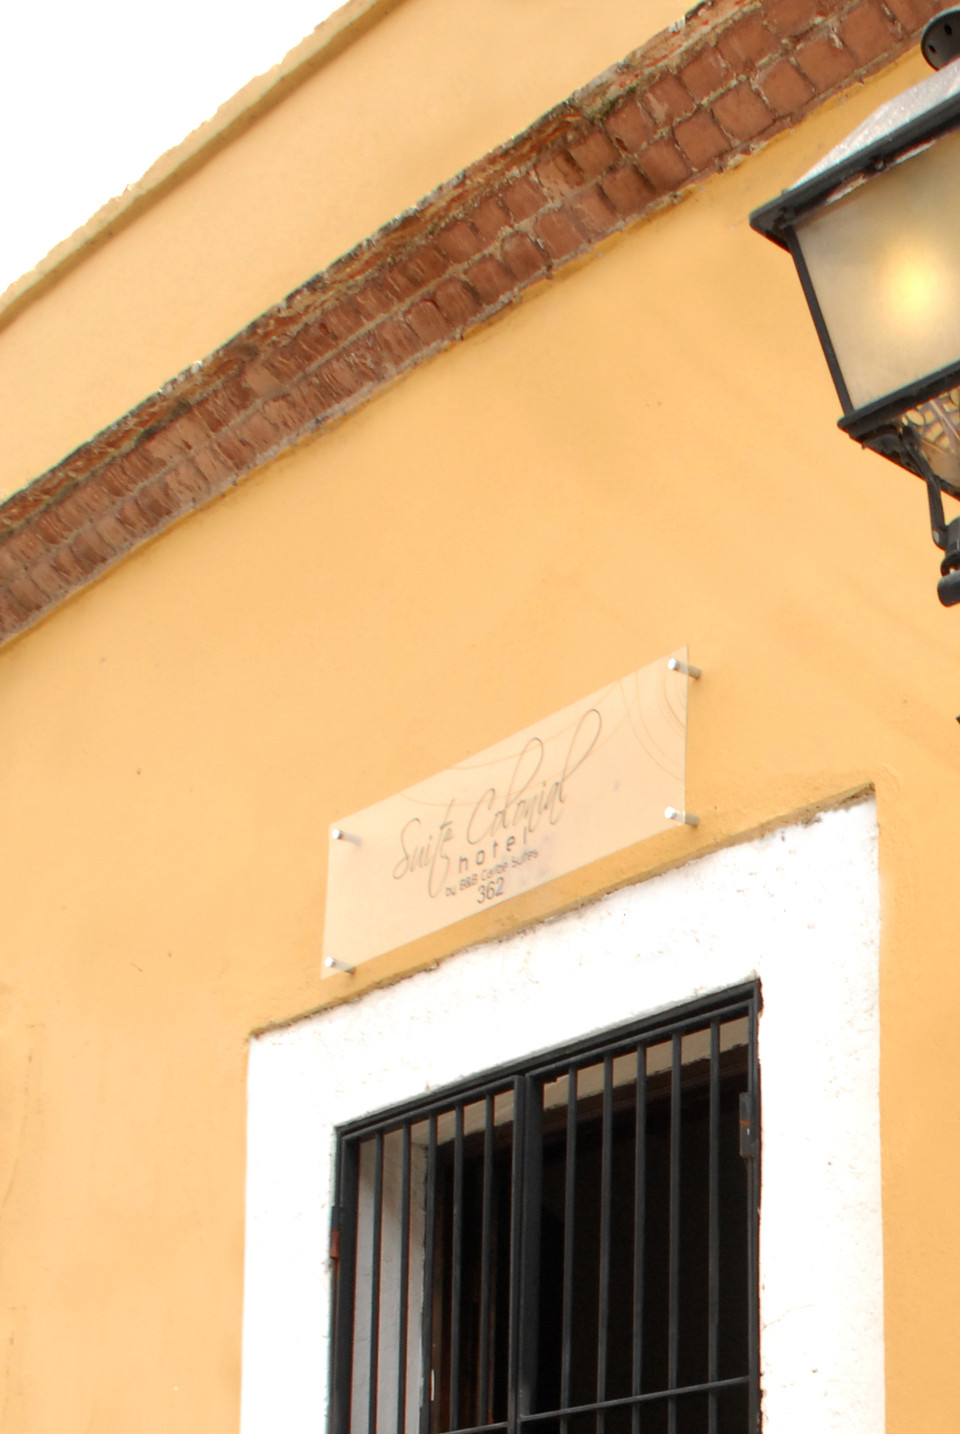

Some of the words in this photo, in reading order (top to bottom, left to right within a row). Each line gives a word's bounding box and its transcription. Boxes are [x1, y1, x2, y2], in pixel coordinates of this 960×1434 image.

[392, 797, 454, 898] Suite
[458, 826, 527, 875] hotel
[476, 876, 505, 904] 362
